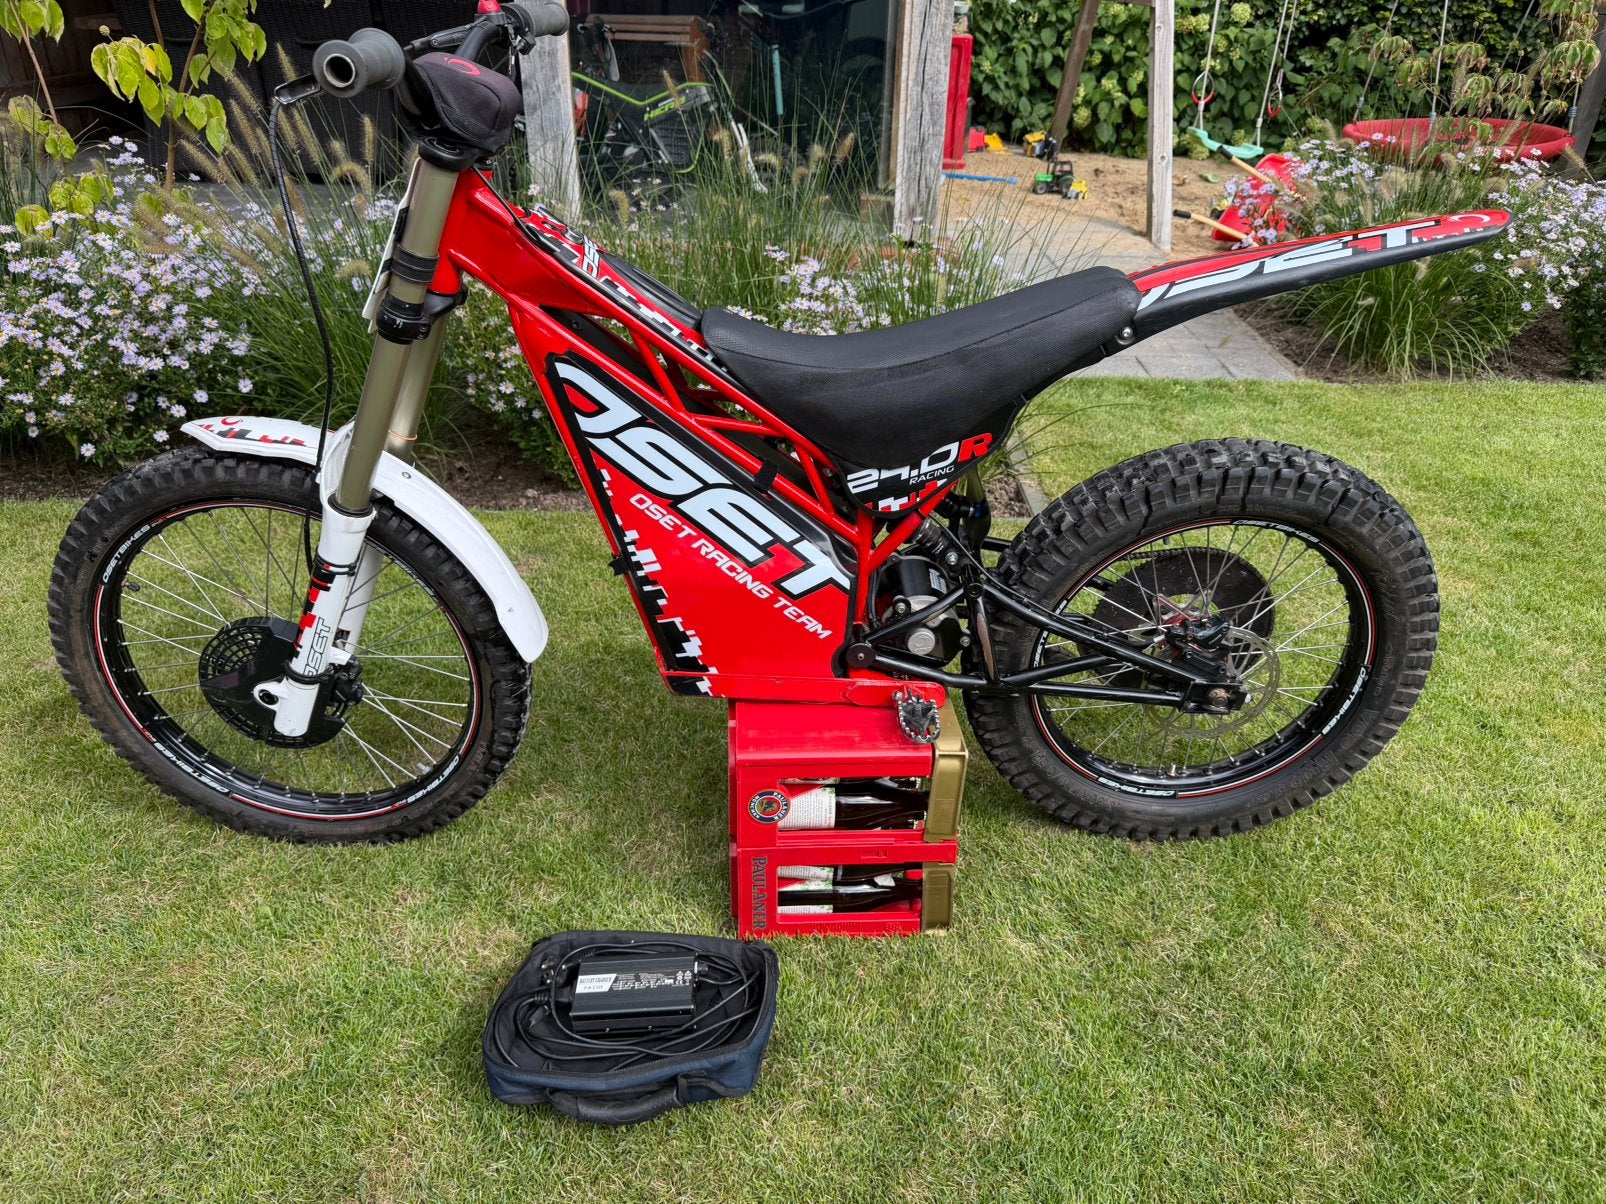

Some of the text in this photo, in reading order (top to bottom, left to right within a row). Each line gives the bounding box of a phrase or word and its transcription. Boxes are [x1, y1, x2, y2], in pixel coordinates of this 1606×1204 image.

[554, 361, 851, 597] OSET
[909, 465, 955, 486] RACING
[102, 524, 151, 583] OSETBIKES
[1233, 520, 1320, 543] OSETBIKES
[629, 493, 832, 639] OSET RACING TEAM
[1322, 667, 1366, 735] OSETBIKES
[154, 742, 230, 793] OSETBIKES
[407, 754, 460, 804] OSETBIKES
[1098, 777, 1175, 796] OSETBIKES
[773, 791, 788, 820] PAULANER
[751, 856, 768, 931] PAULANER
